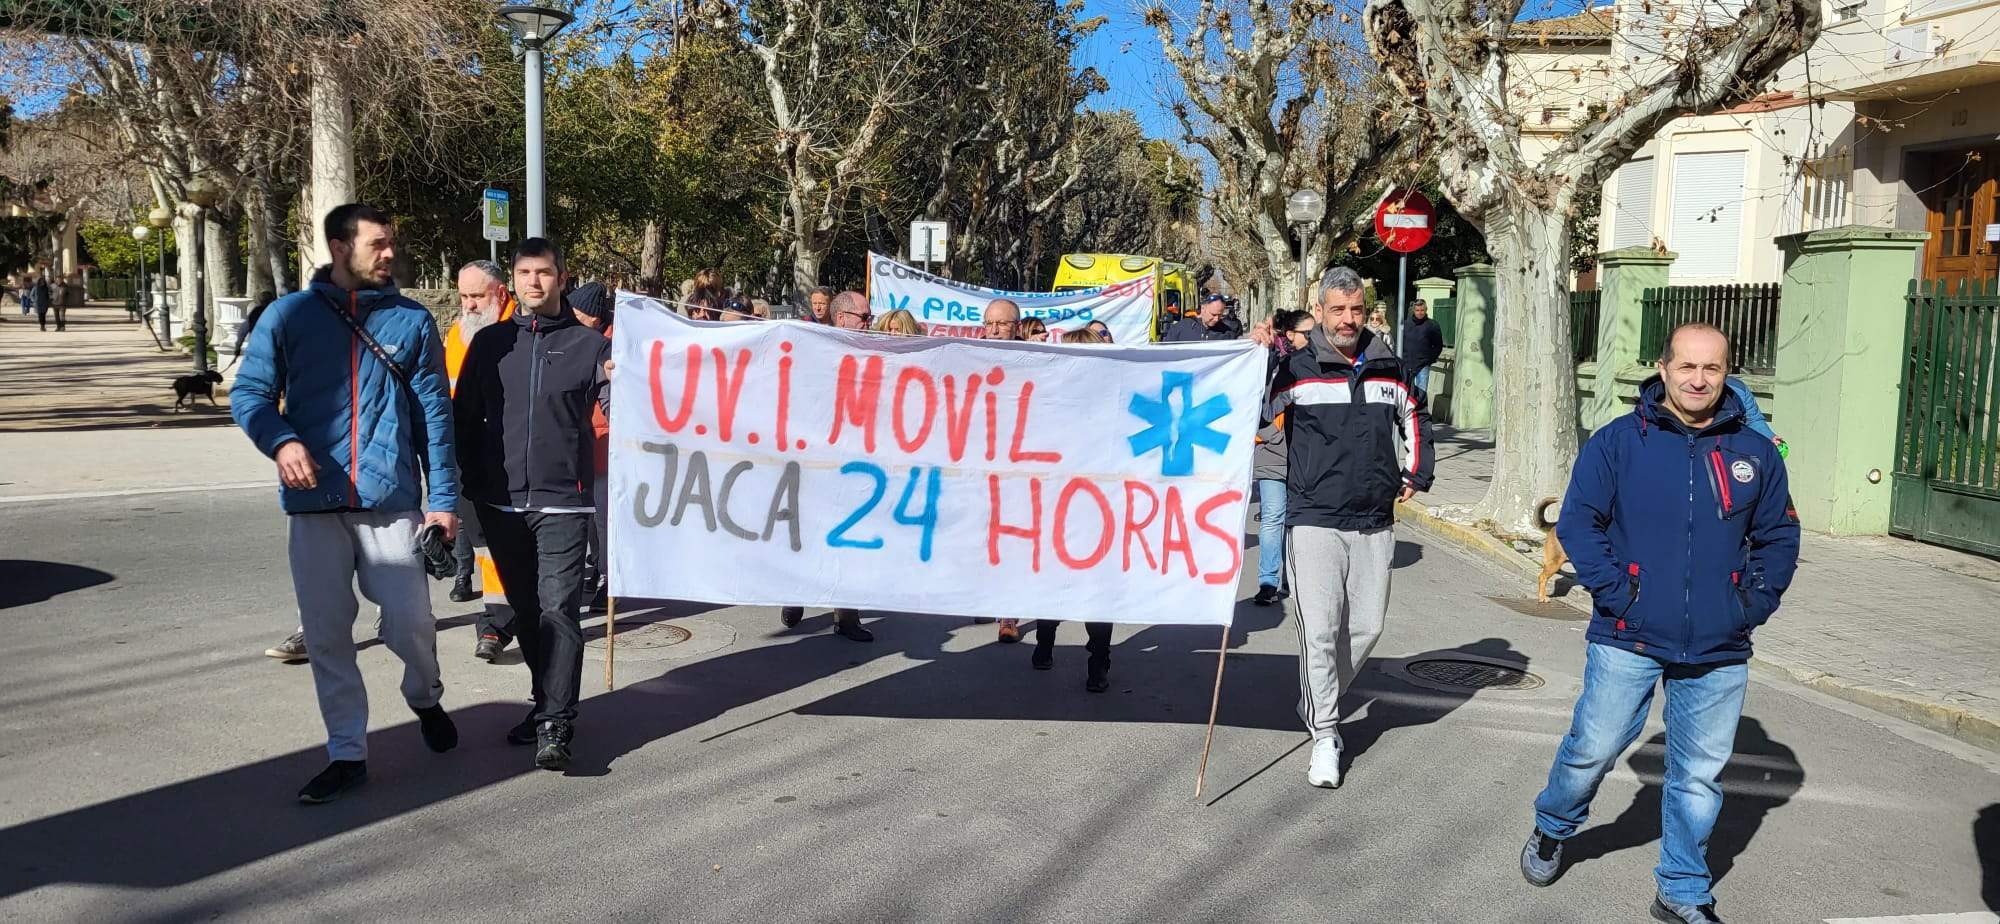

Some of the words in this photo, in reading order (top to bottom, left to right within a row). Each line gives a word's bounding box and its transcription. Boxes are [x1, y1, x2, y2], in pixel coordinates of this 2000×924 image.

[923, 297, 1093, 321] PREERDO
[636, 442, 801, 552] JACA
[826, 461, 941, 562] 24
[989, 475, 1241, 583] HORAS
